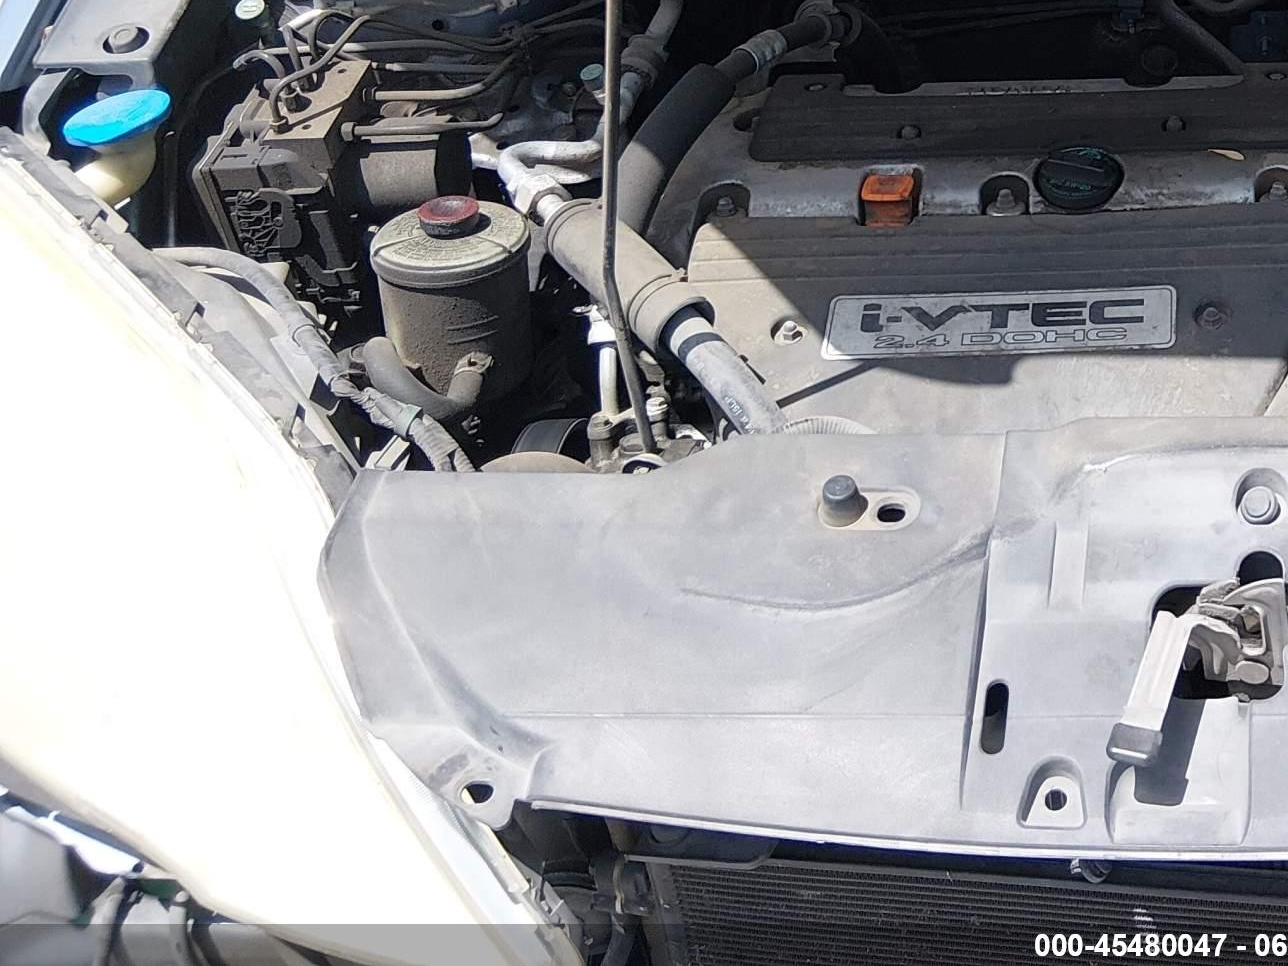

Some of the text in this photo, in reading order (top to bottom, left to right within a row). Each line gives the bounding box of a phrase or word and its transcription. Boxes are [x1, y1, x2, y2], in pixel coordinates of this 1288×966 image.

[860, 298, 1145, 333] i-VTEC
[873, 327, 1128, 350] 2.4 DOHC
